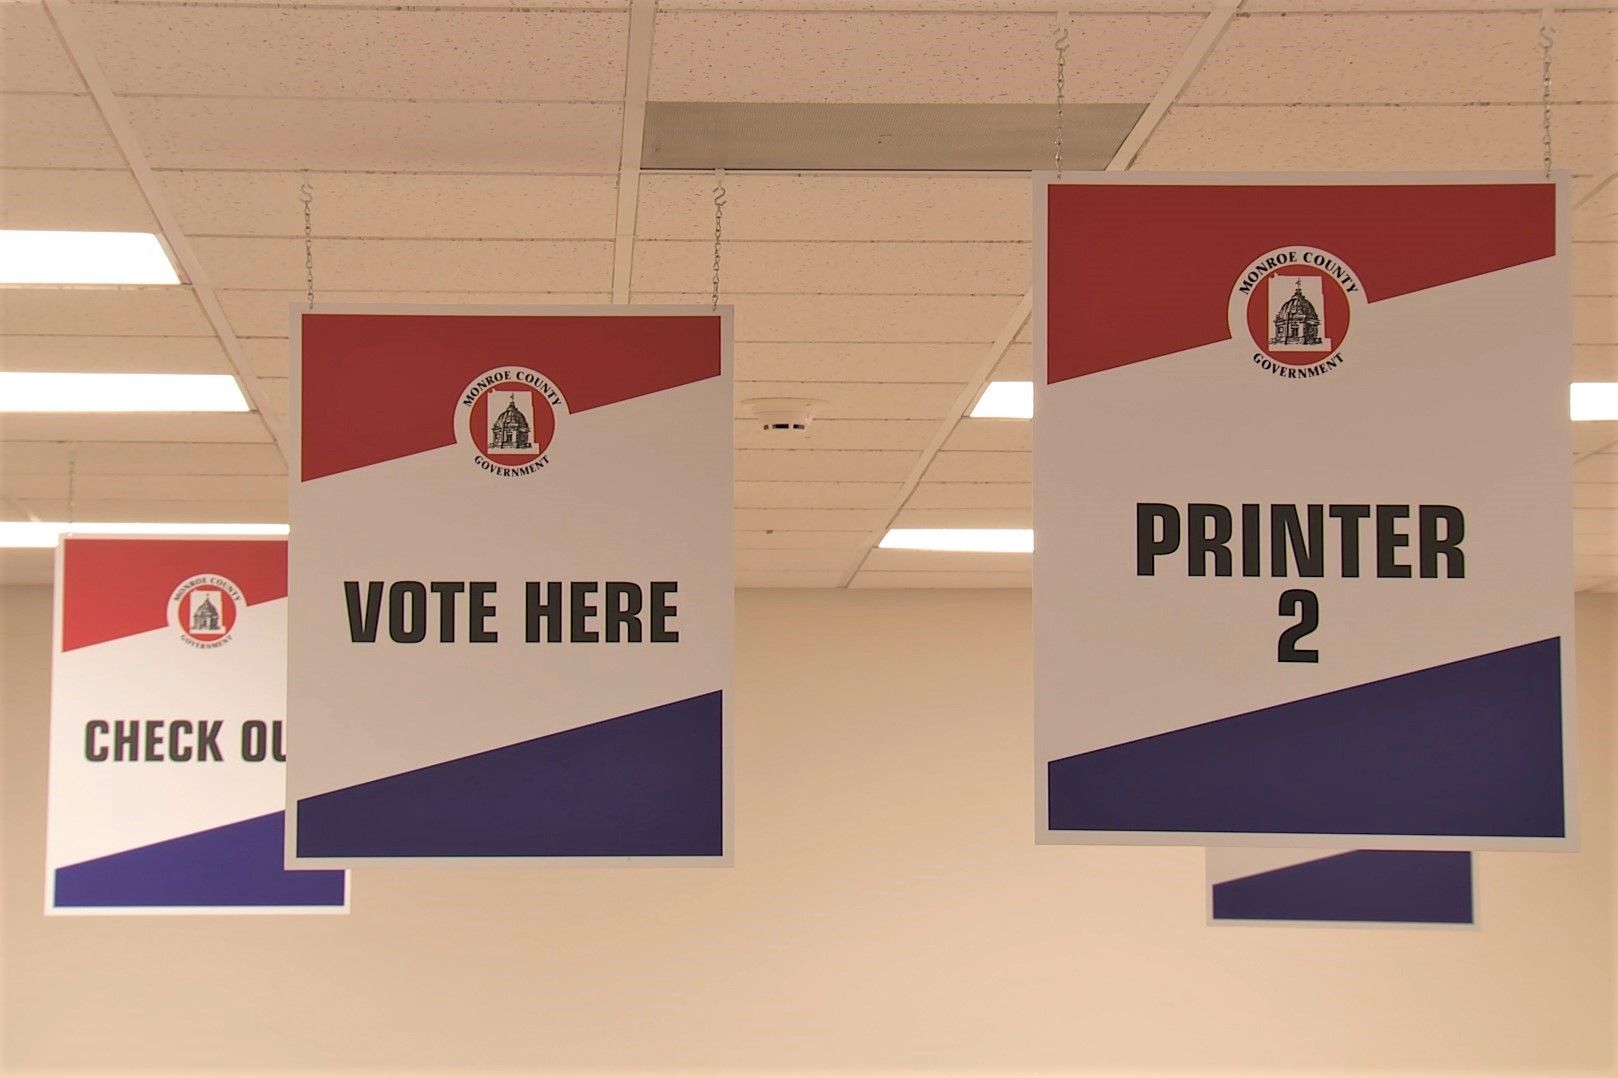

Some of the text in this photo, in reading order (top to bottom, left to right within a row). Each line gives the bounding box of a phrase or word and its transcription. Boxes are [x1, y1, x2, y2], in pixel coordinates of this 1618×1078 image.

[1239, 251, 1358, 295] MONROE COUNTY
[1253, 352, 1344, 379] GOVERNMENT
[463, 370, 561, 407] MONROE COUNTY
[474, 455, 550, 477] GOVERNMENT
[1137, 503, 1465, 578] PRINTER
[344, 581, 679, 643] VOTE HERE
[1278, 589, 1319, 663] 2
[85, 720, 286, 762] CHECK OU
